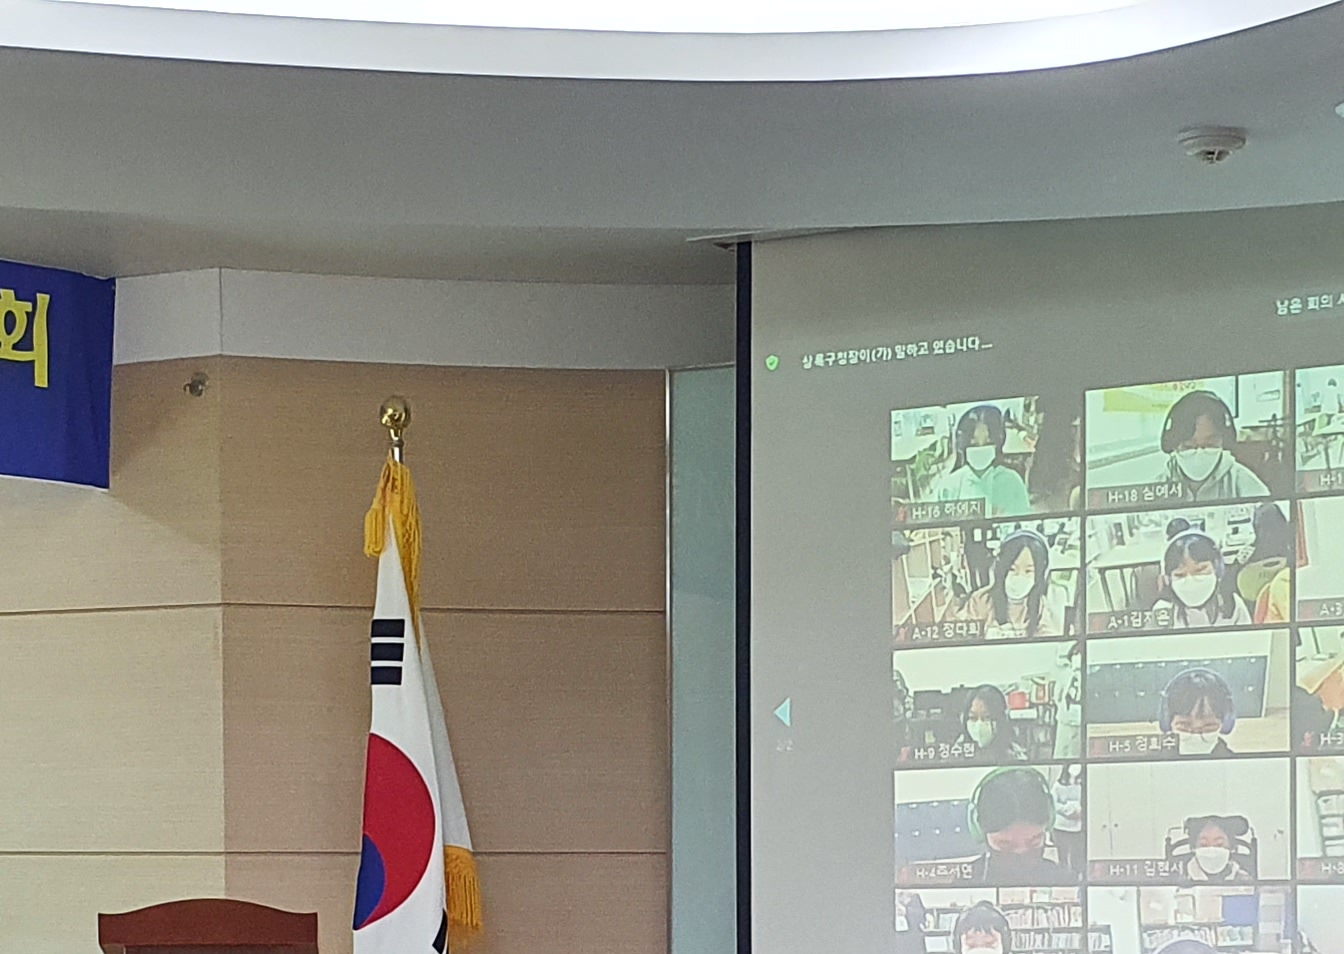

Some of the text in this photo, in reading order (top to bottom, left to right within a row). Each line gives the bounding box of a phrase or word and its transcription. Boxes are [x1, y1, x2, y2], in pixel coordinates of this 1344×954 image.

[1275, 297, 1303, 316] 남은
[1306, 294, 1334, 312] 회의
[894, 341, 929, 360] 말하고
[1107, 489, 1138, 504] H-18
[1319, 603, 1343, 617] A-3
[912, 627, 940, 641] A-12
[913, 747, 936, 760] H-9
[1109, 863, 1138, 876] H-11
[1320, 861, 1344, 875] H-8
